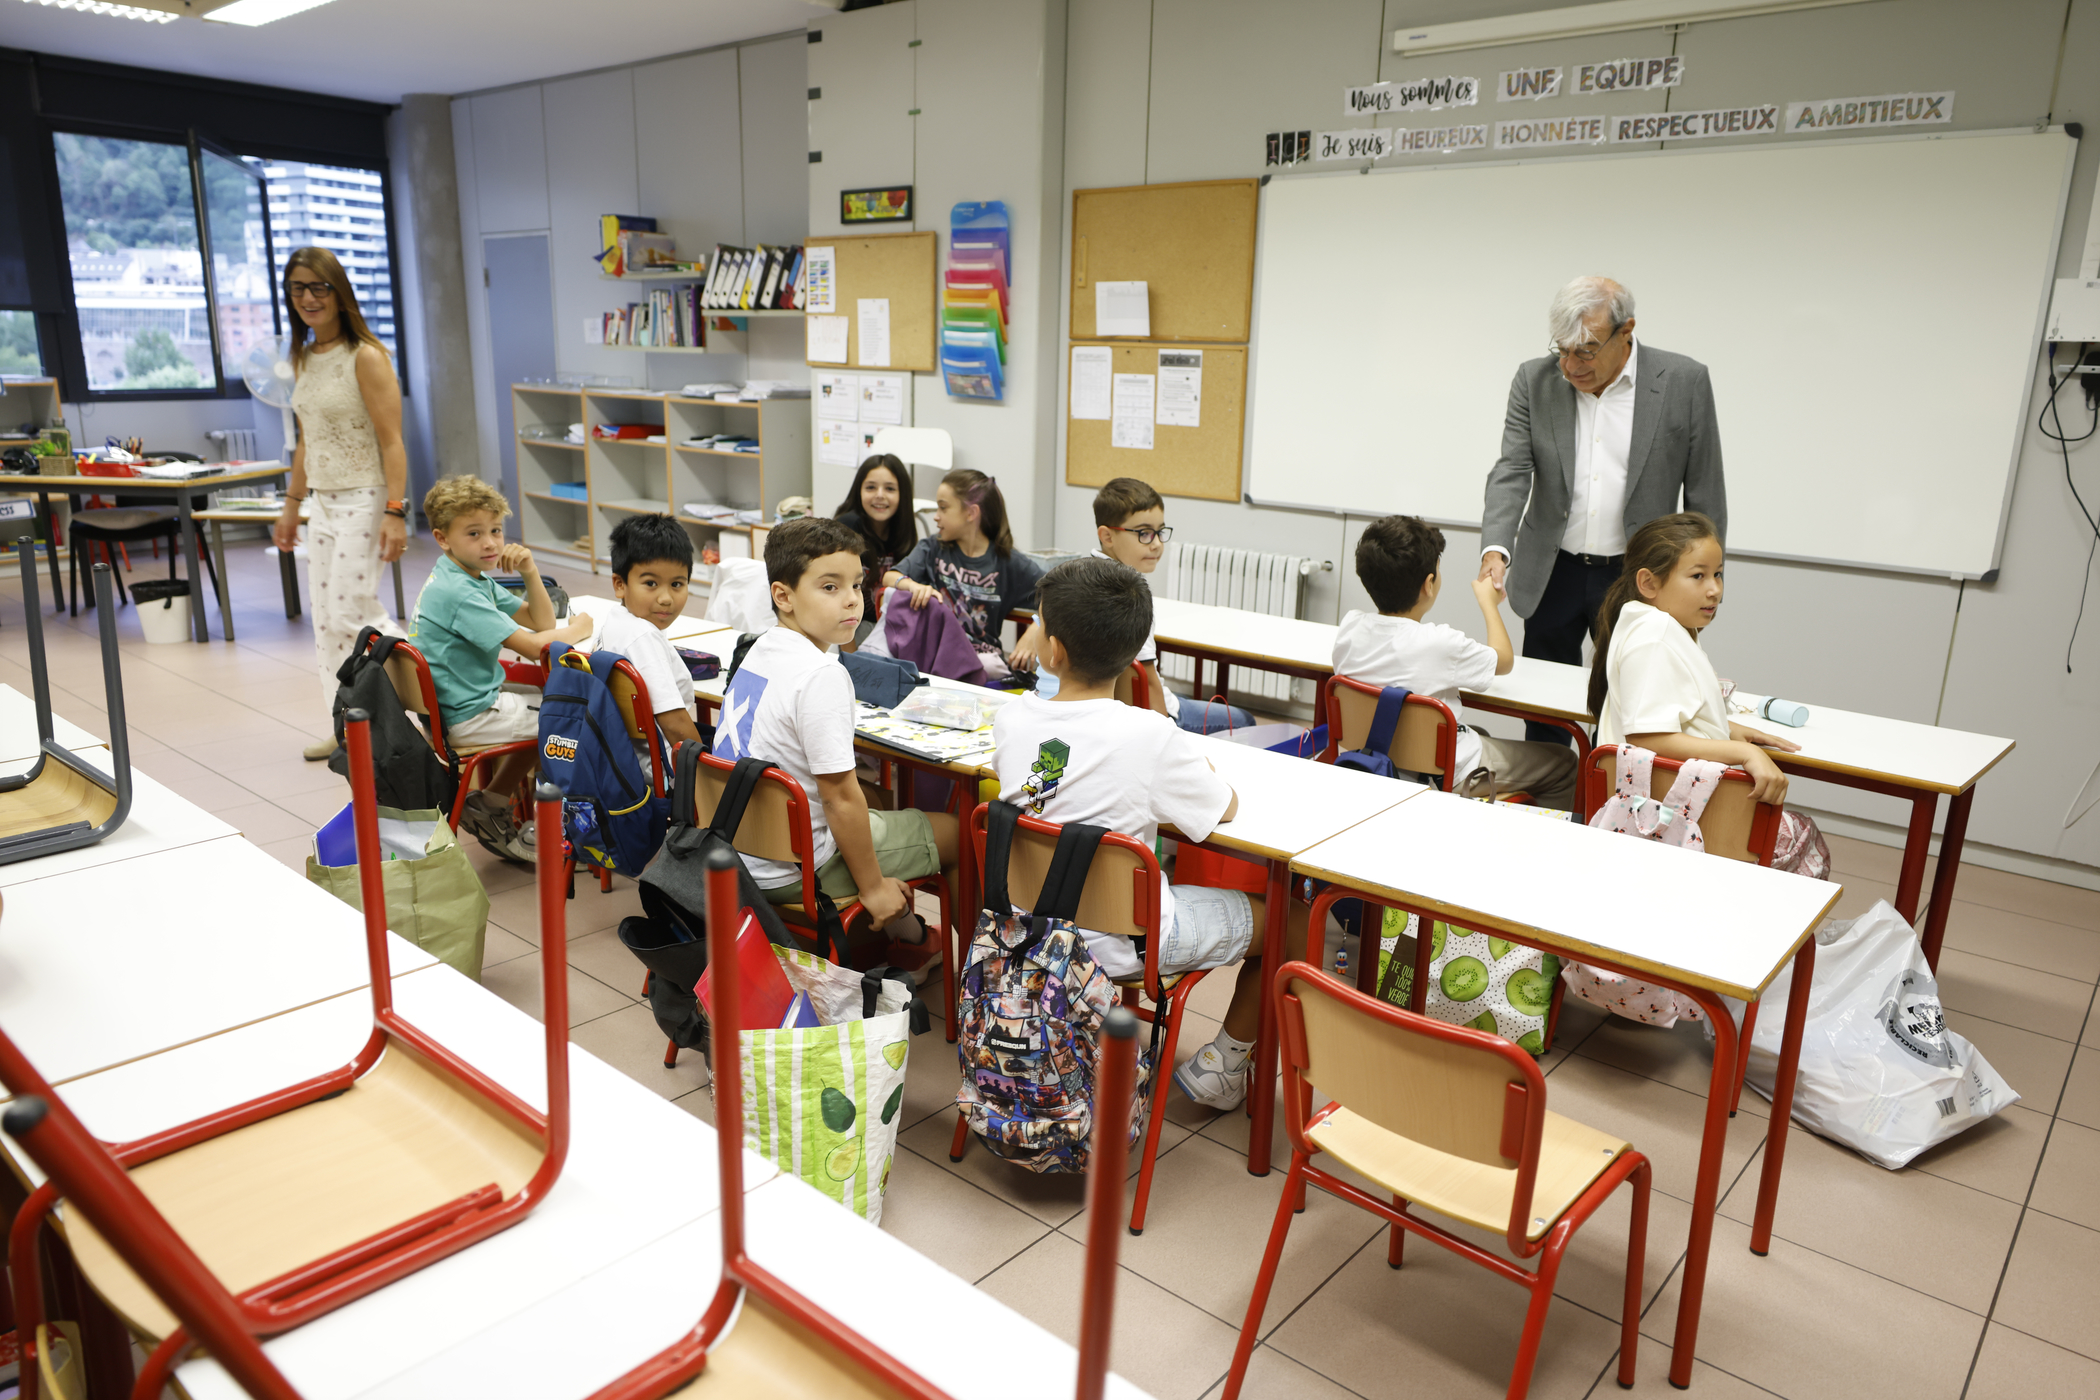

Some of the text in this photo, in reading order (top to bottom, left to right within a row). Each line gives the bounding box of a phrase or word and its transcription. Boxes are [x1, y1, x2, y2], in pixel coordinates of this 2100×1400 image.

[1507, 57, 1679, 97] UNE EQUIPE
[1351, 78, 1473, 112] Nous sommes
[1321, 134, 1342, 157] Je
[1348, 133, 1385, 157] suis
[1401, 126, 1485, 150] HEUREUX
[1618, 107, 1776, 140] RESPECTUEUX
[1795, 96, 1946, 129] AMBITIEUX
[1269, 137, 1308, 159] ICI
[546, 743, 576, 759] GUYS
[1391, 960, 1415, 980] TE QUI
[1395, 975, 1411, 992] 100%
[1388, 987, 1410, 1006] VERDE
